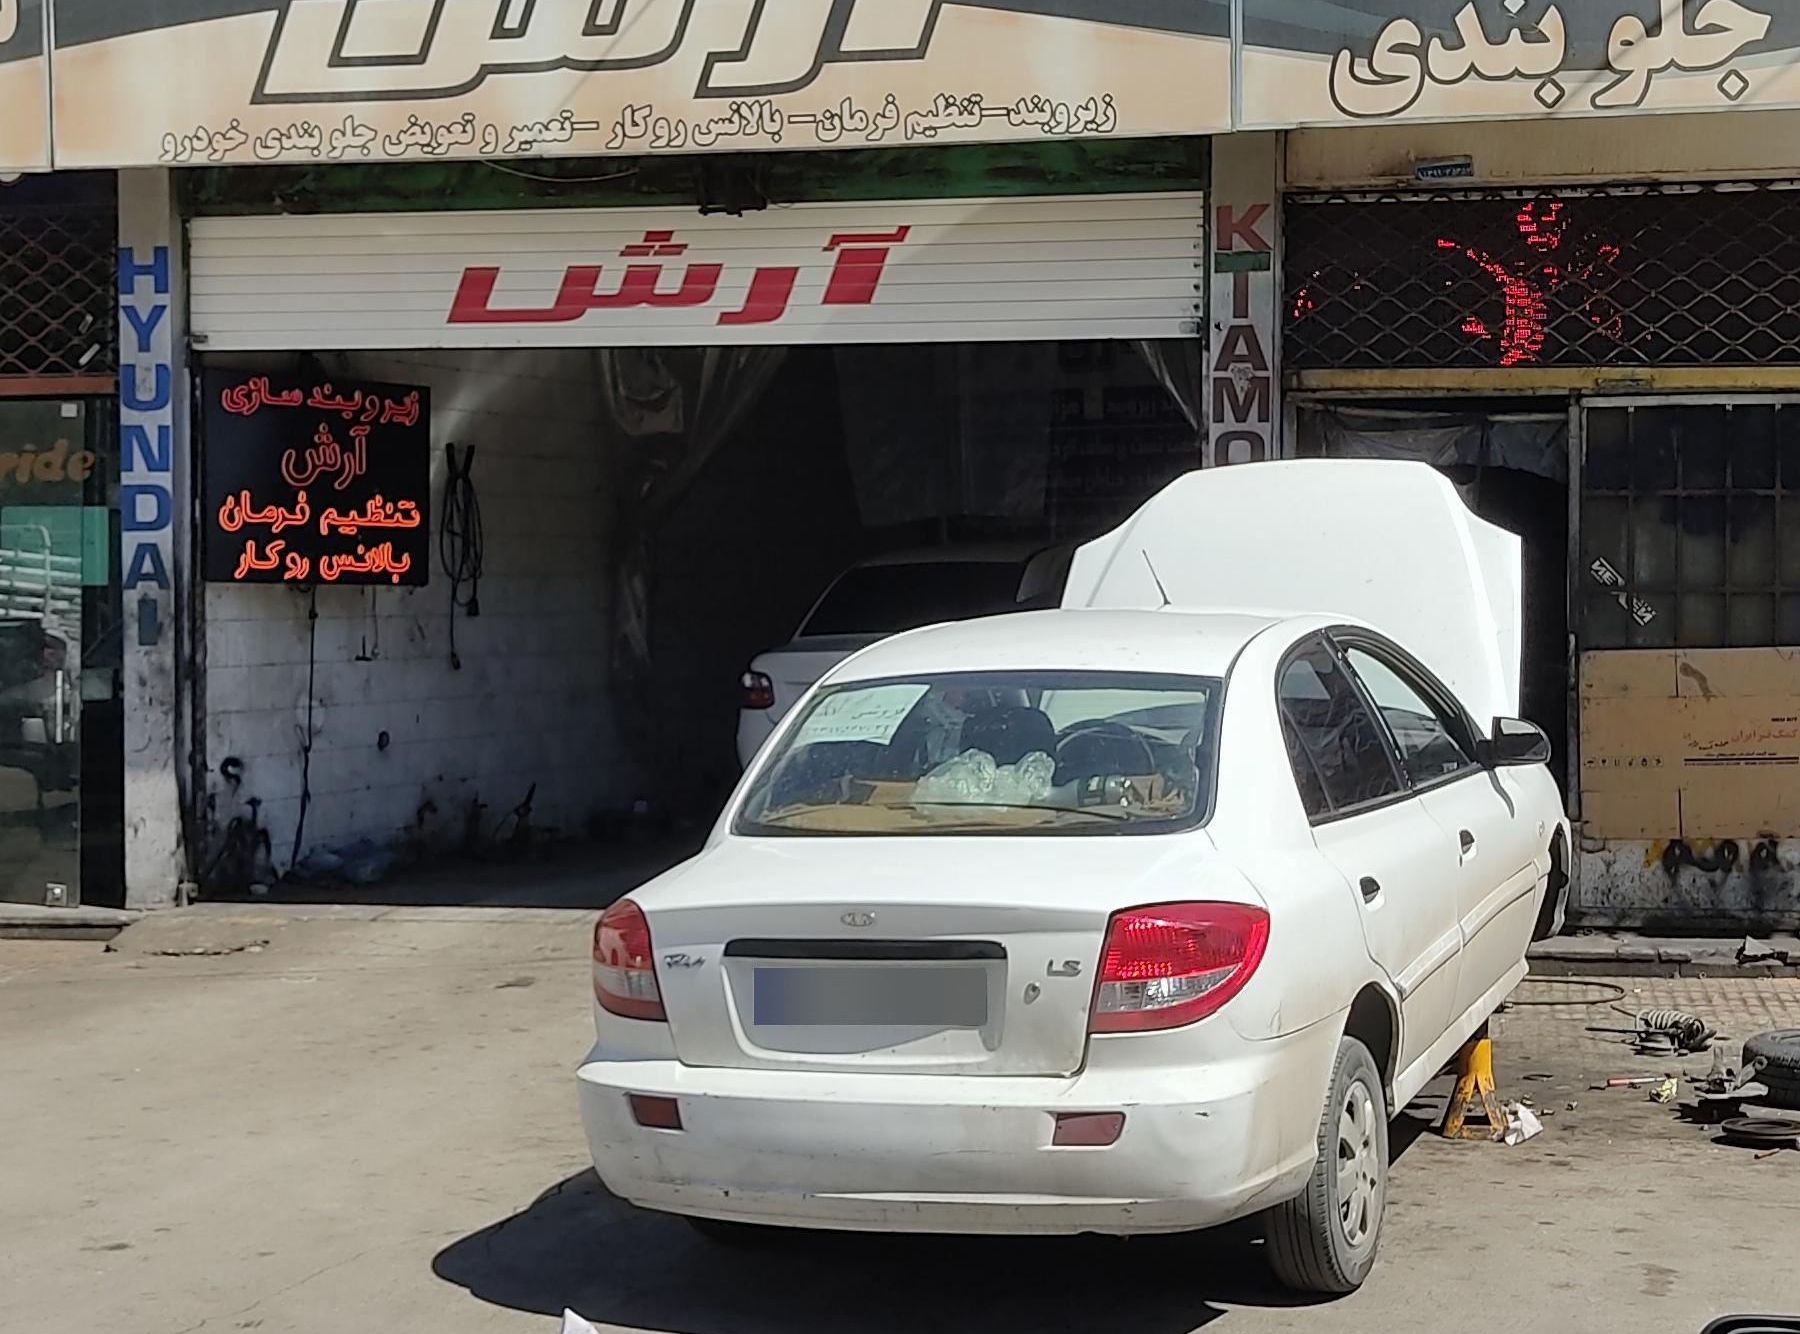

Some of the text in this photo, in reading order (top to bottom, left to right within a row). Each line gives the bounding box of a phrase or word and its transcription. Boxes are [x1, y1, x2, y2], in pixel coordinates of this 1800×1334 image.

[159, 118, 249, 162] خودرو
[383, 113, 475, 157] تعویض
[479, 124, 498, 154] و
[692, 100, 784, 146] بالانس
[446, 225, 911, 325] آرش
[118, 246, 173, 647] HYUNDAI
[281, 421, 371, 490] آرش
[218, 489, 421, 535] تنظیم فرمان
[319, 540, 411, 584] بالانس
[1046, 958, 1082, 977] LS
